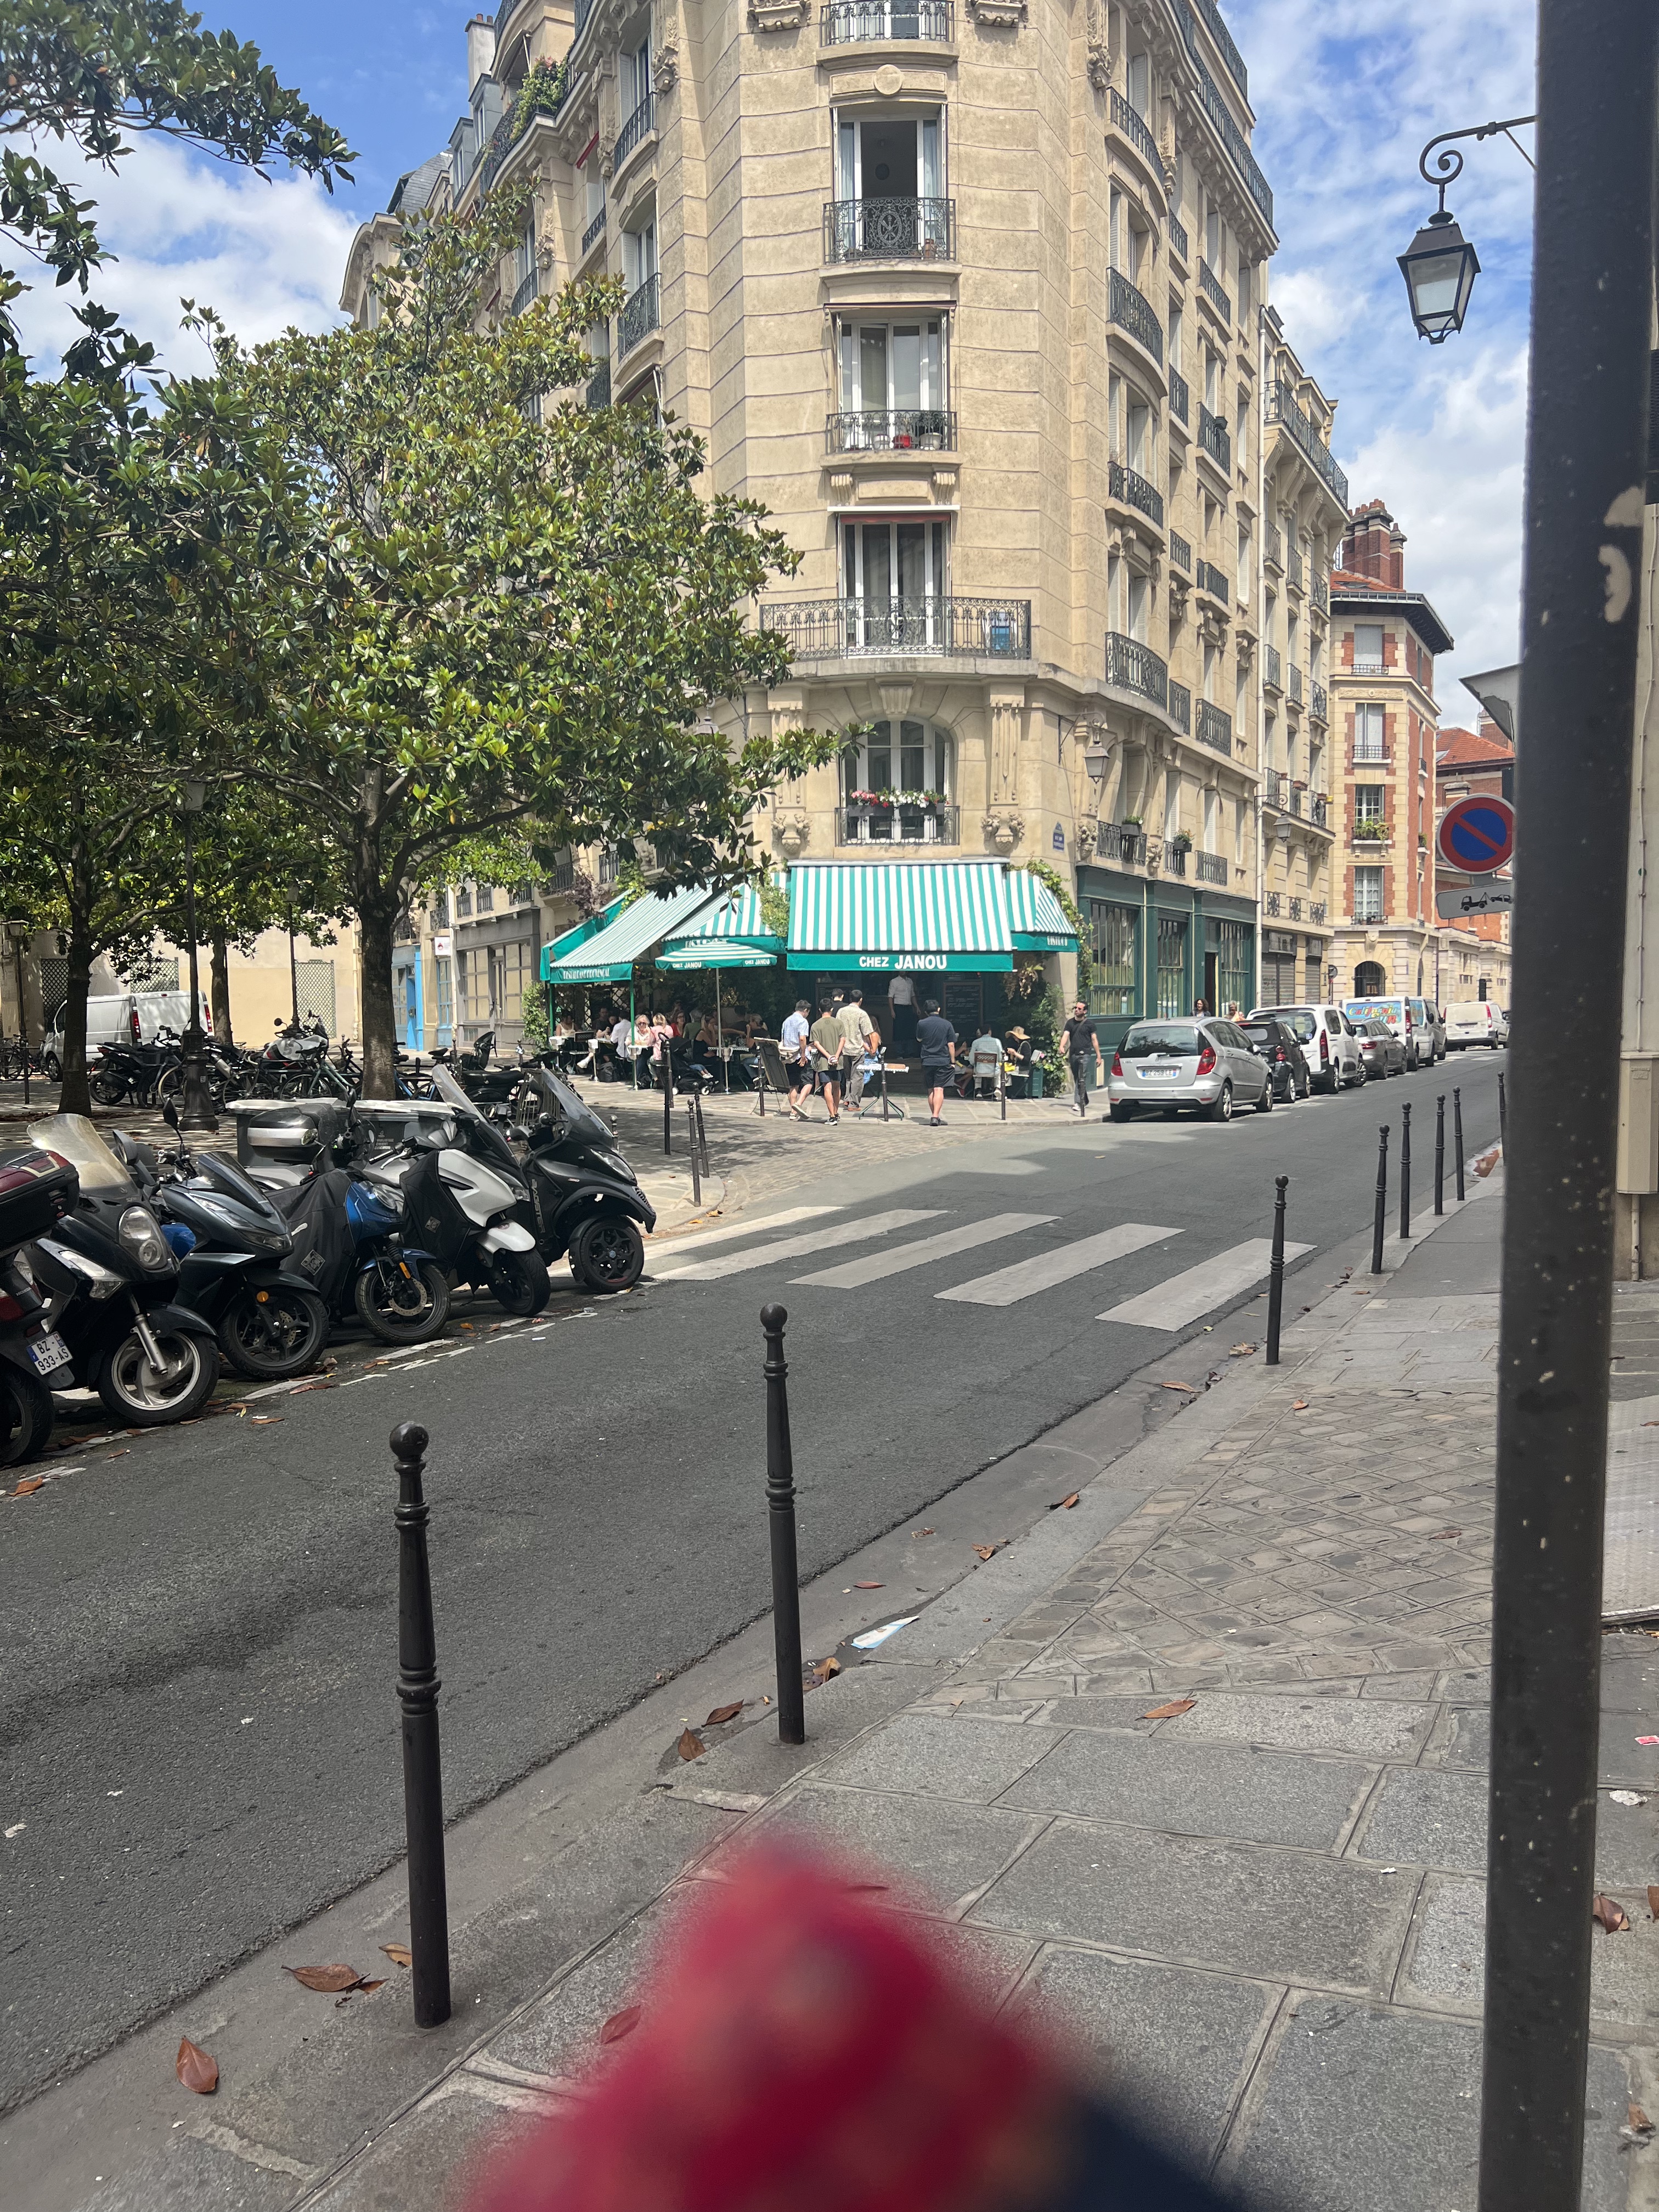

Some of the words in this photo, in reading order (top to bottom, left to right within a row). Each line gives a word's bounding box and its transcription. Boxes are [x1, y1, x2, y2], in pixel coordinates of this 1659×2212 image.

[859, 956, 889, 967] CHEZ
[894, 955, 947, 969] JANOU
[1348, 1006, 1397, 1017] California
[532, 1179, 546, 1233] BAGSTER
